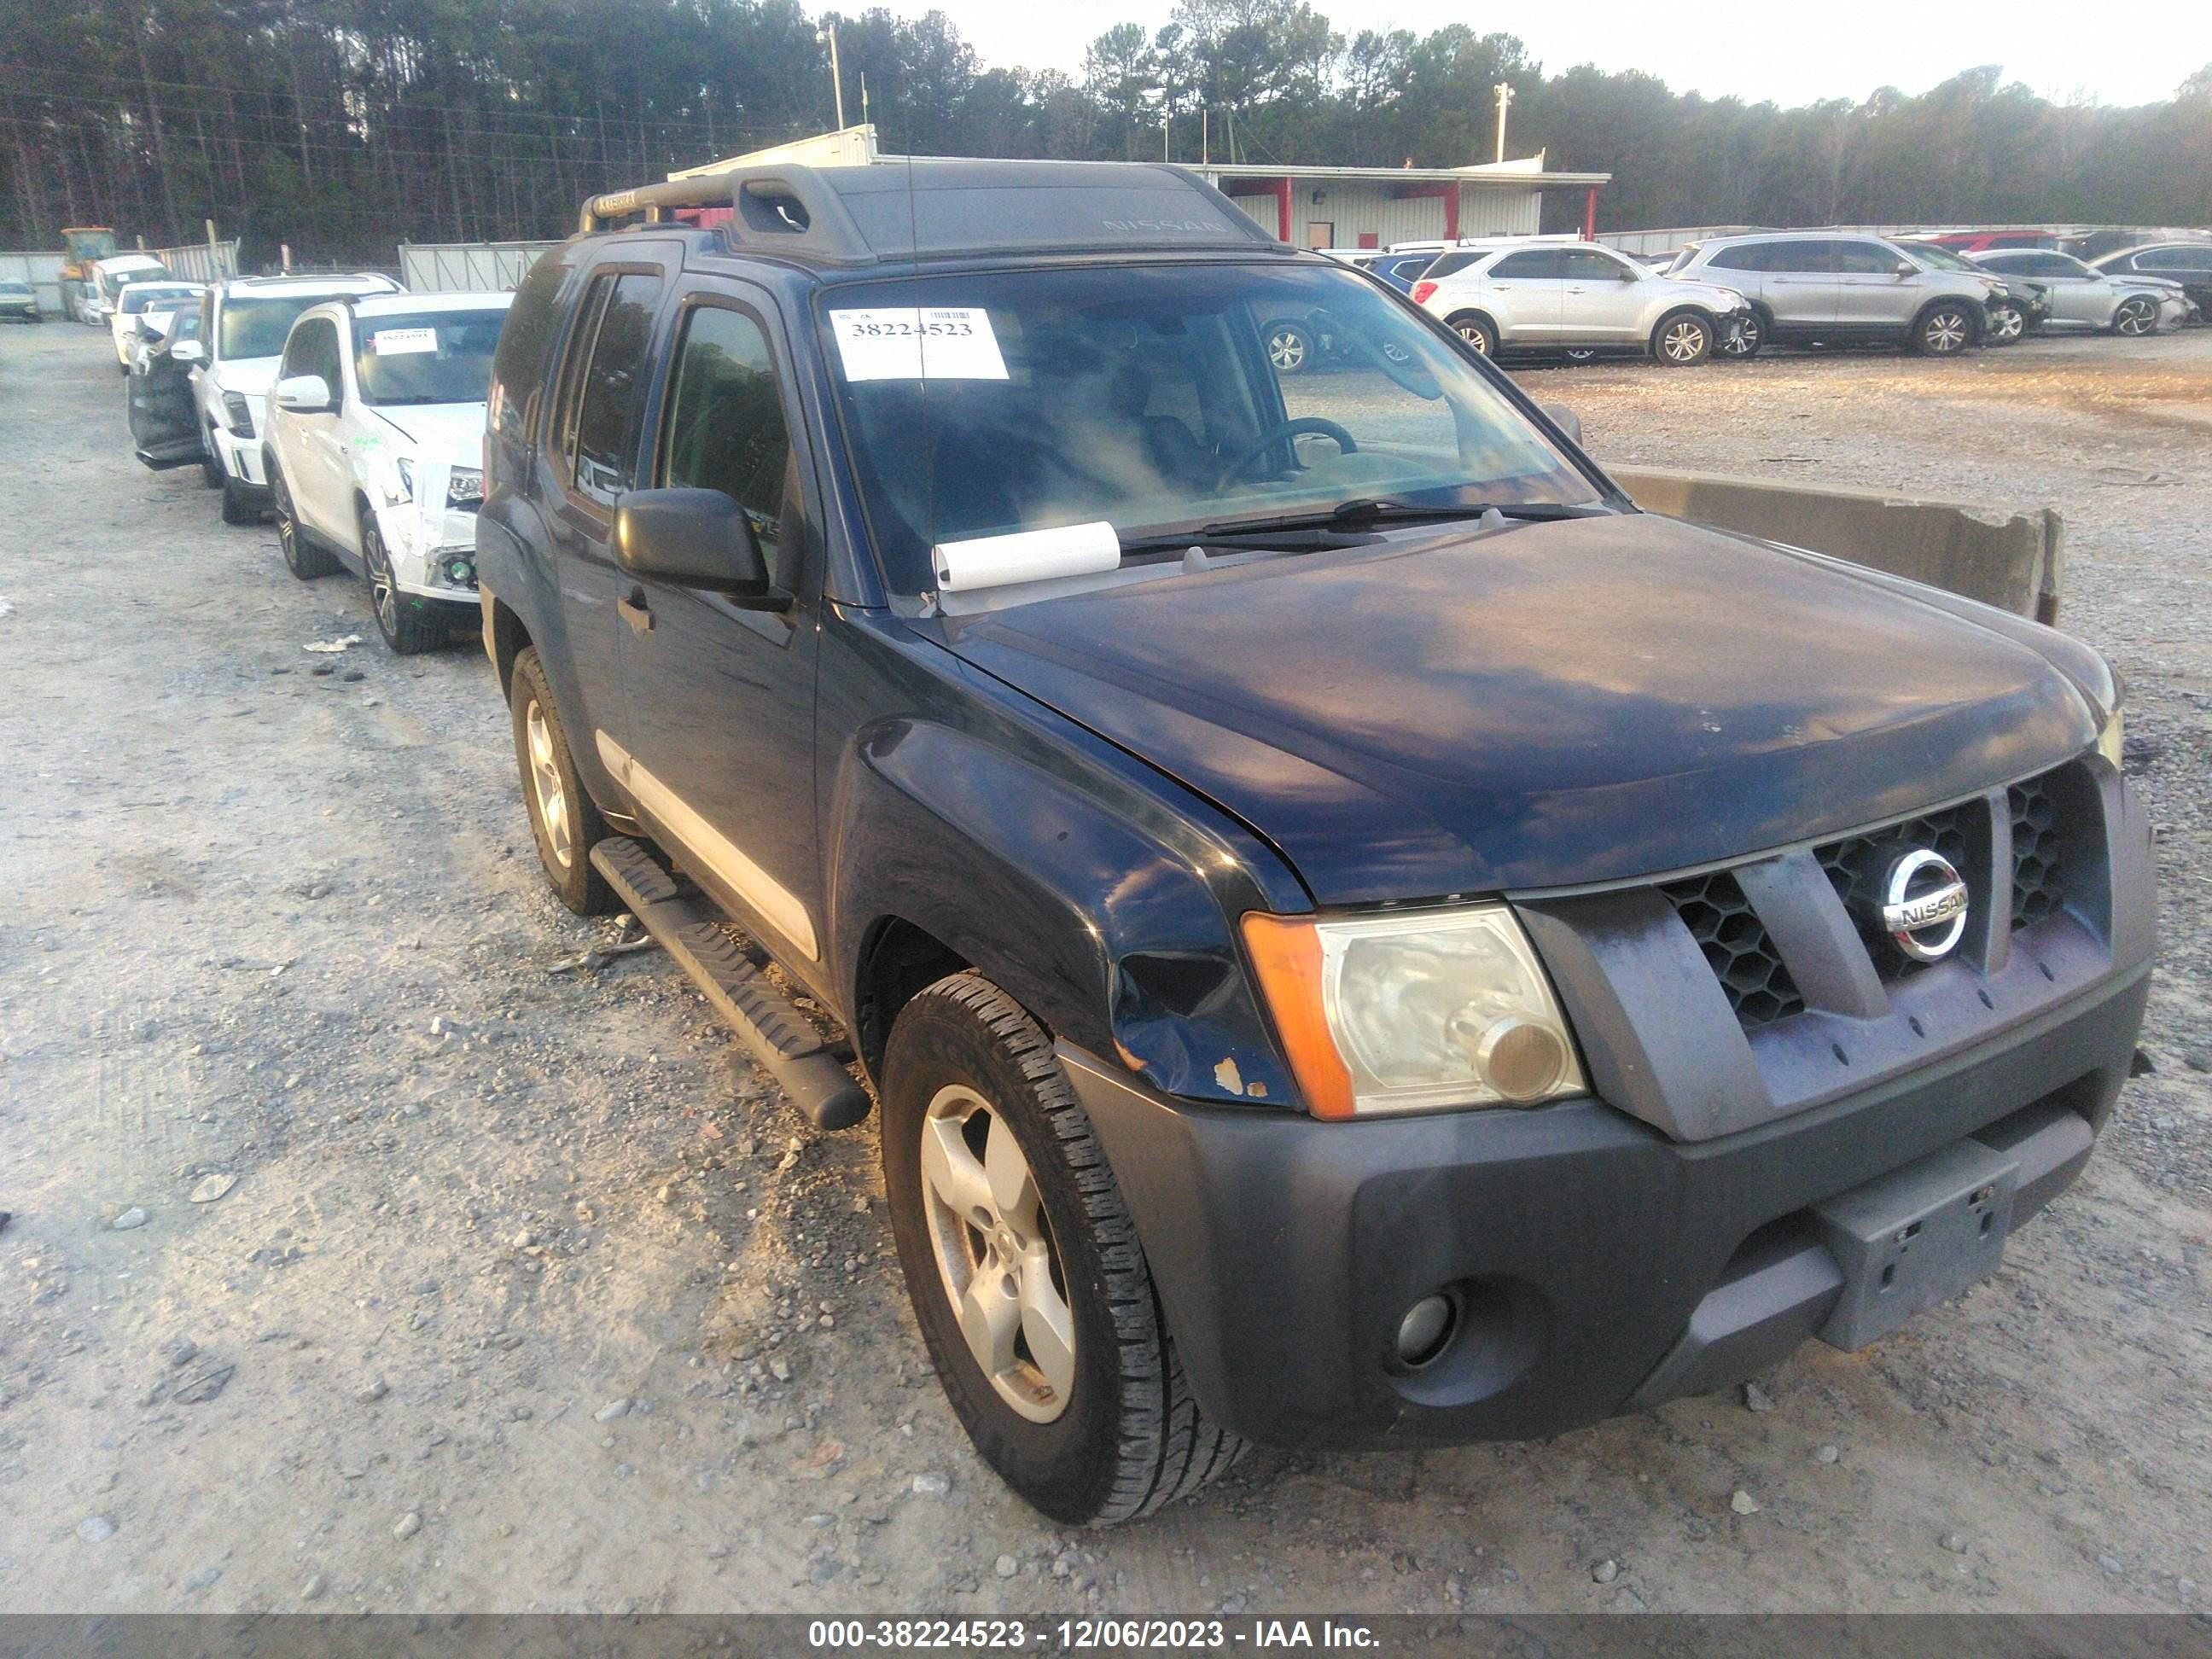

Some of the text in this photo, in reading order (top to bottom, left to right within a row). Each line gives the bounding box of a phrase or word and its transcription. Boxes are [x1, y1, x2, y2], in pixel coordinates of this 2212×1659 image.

[1102, 220, 1228, 233] NISSAN
[852, 323, 973, 336] 38224523
[1901, 892, 1966, 924] NISSAN
